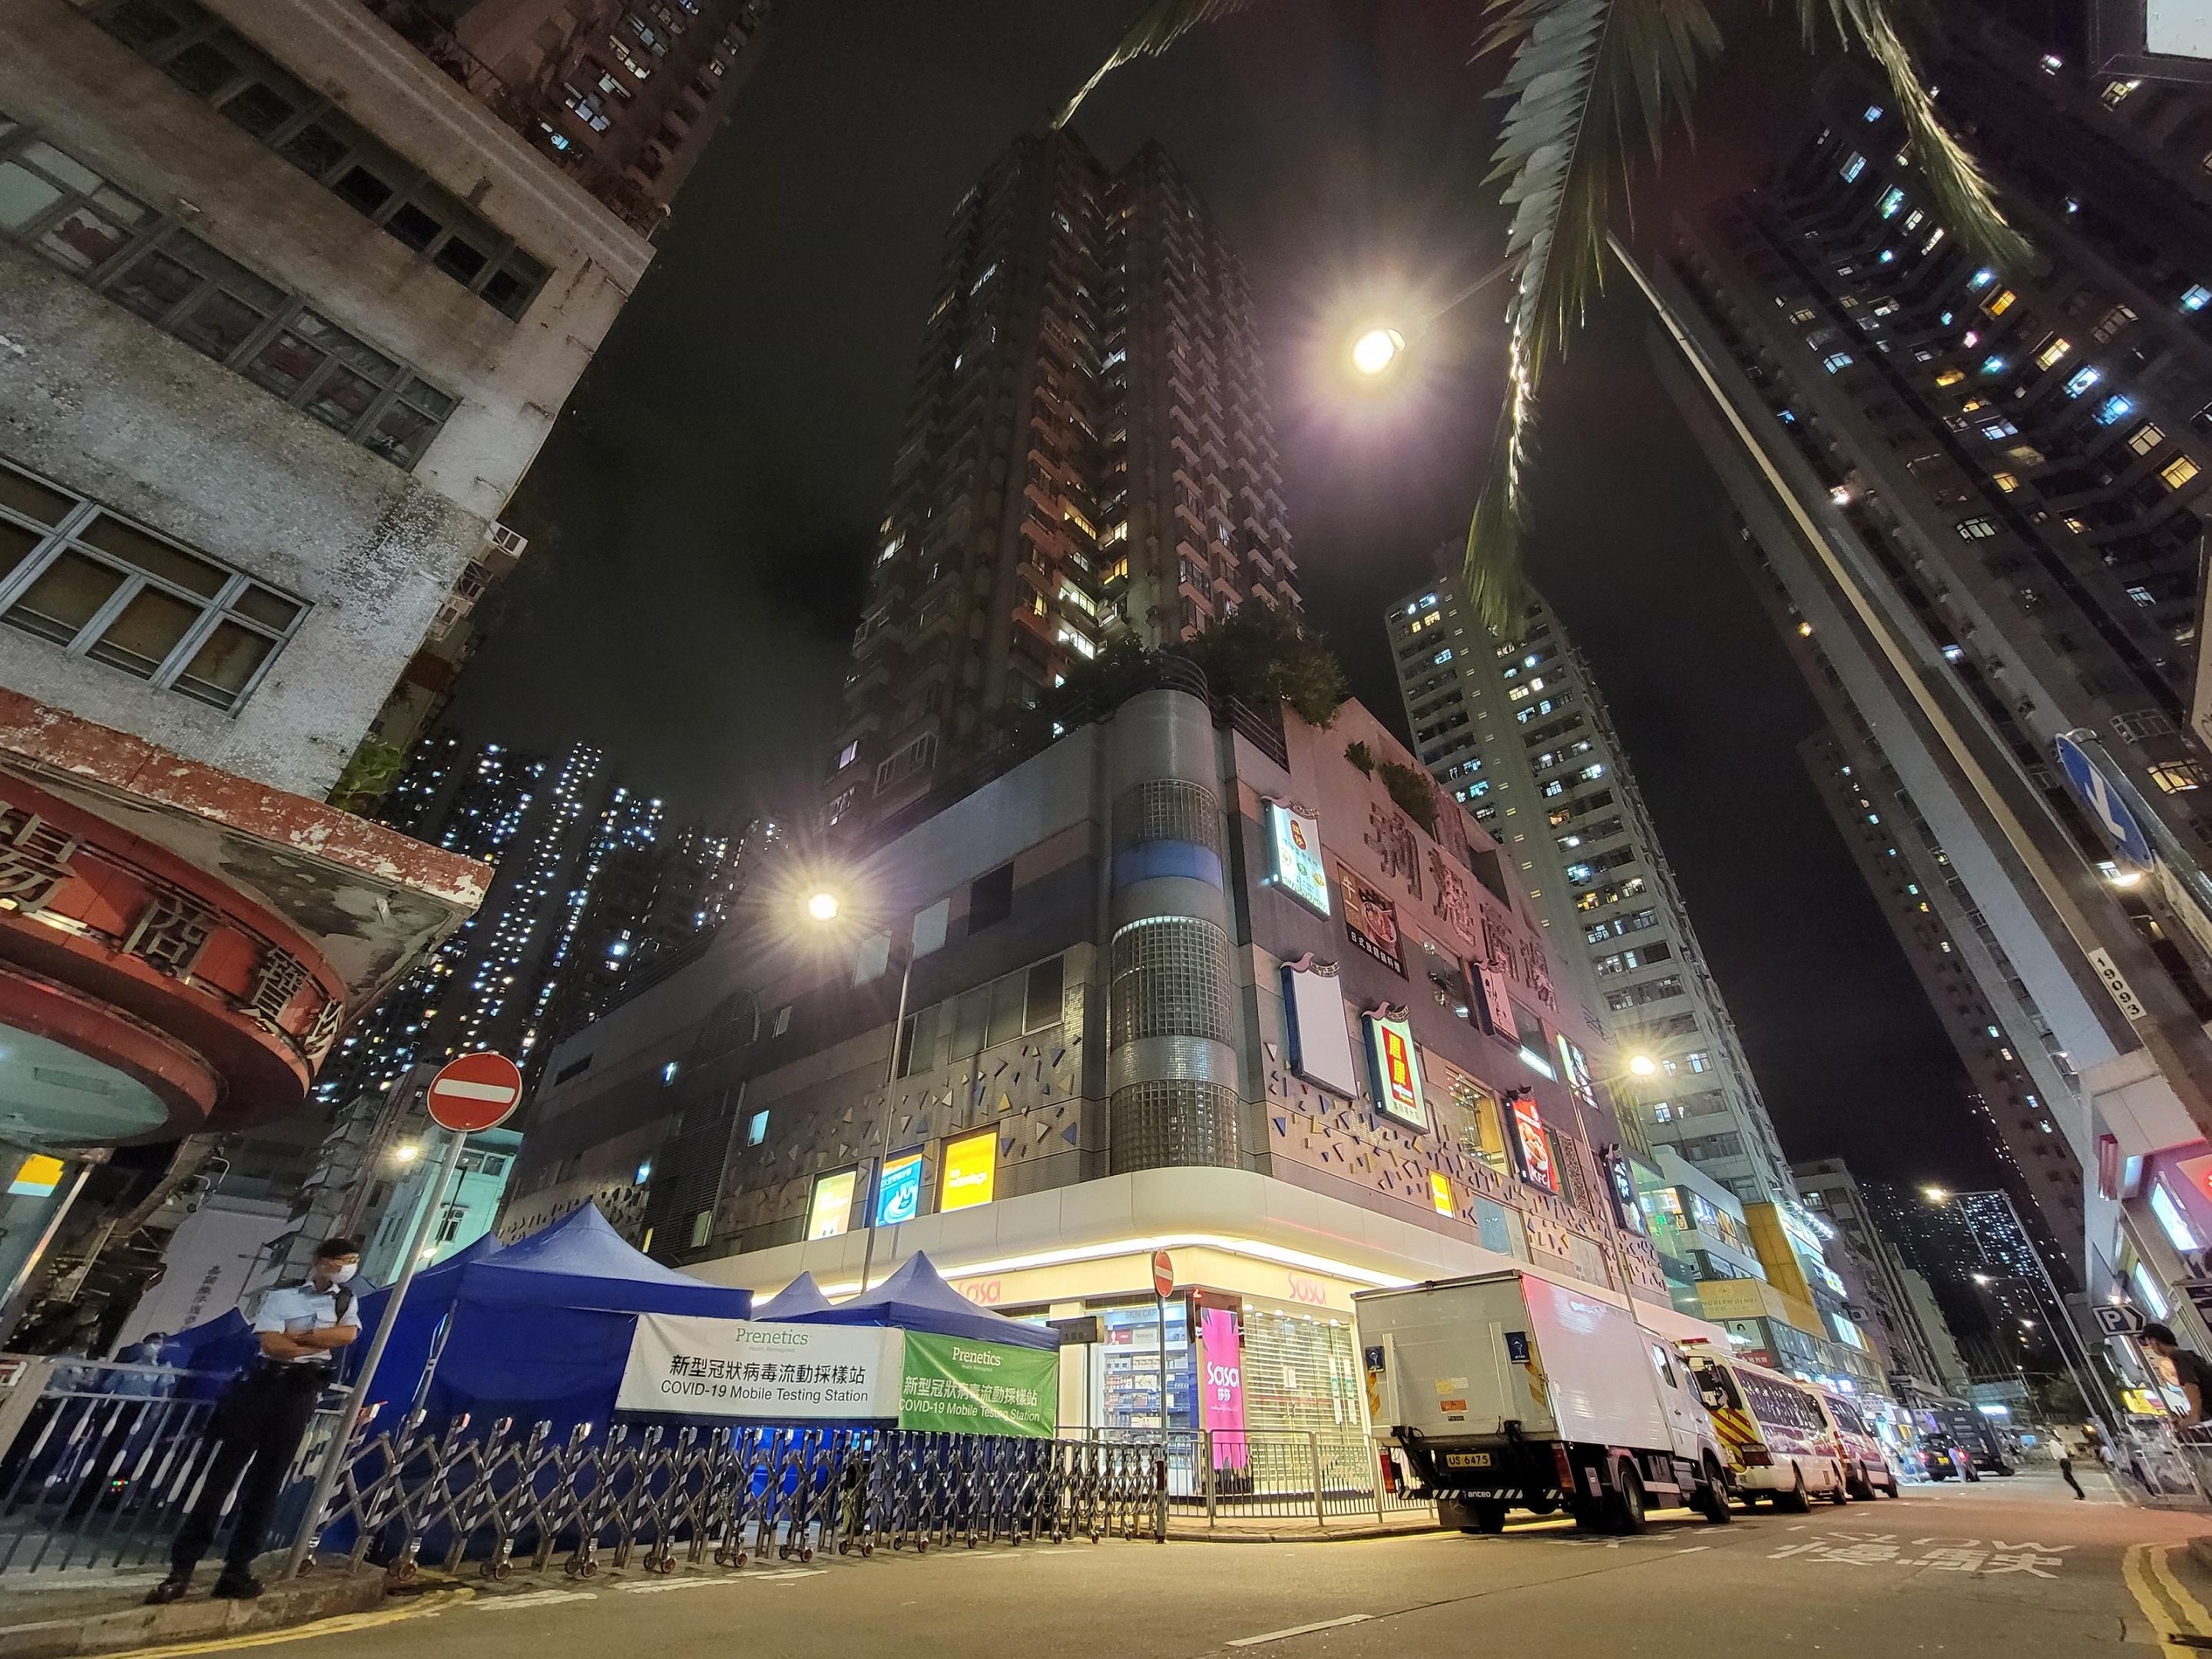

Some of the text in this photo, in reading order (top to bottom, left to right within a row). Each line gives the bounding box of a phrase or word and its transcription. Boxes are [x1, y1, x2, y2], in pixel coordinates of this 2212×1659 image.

[2097, 957, 2141, 1015] 19093
[1389, 1032, 1406, 1086] 惠康
[1532, 1170, 1548, 1185] KFC
[1124, 1308, 1158, 1319] SKIN CAR
[2101, 1310, 2122, 1330] P
[735, 1327, 809, 1346] Prenetics
[952, 1346, 1002, 1366] Prenetics
[669, 1354, 866, 1385] 新型冠狀病毒流動採樣站
[1207, 1361, 1240, 1388] Sasa
[661, 1379, 869, 1404] COVID-19 Mobile Testing Station
[902, 1376, 1038, 1407] 新型冠狀病毒流動採樣站
[898, 1399, 1040, 1422] COVID-19 Mobile Testing Station
[1449, 1455, 1488, 1465] US 6475
